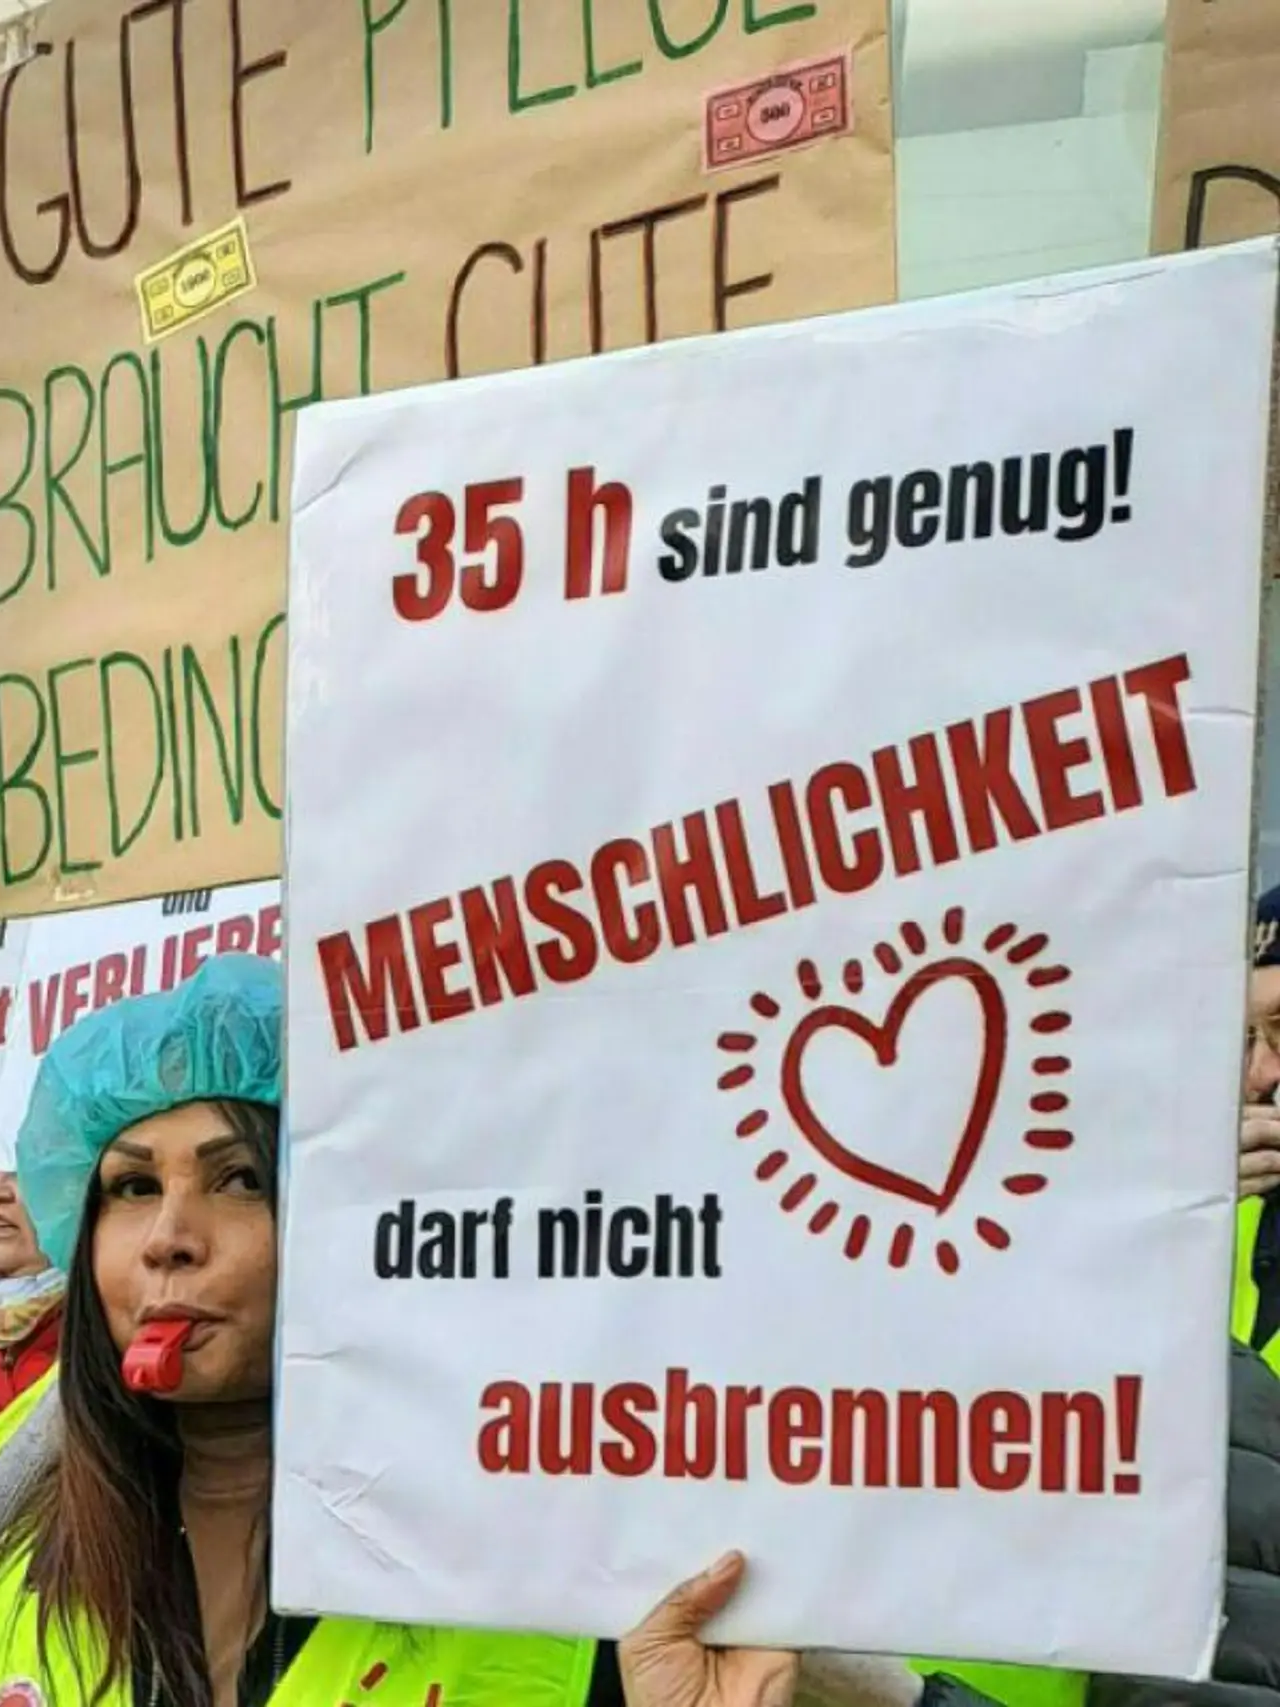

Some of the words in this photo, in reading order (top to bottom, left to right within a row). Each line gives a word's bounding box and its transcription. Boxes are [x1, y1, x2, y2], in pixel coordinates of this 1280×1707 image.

[392, 475, 524, 623] 35
[563, 465, 634, 601] h
[657, 474, 822, 583] sind
[844, 426, 1136, 569] genug!
[317, 652, 1198, 1053] MENSCHLICHKEIT
[372, 1195, 516, 1281] darf
[536, 1187, 724, 1280] nicht
[476, 1367, 1144, 1496] ausbrennen!
